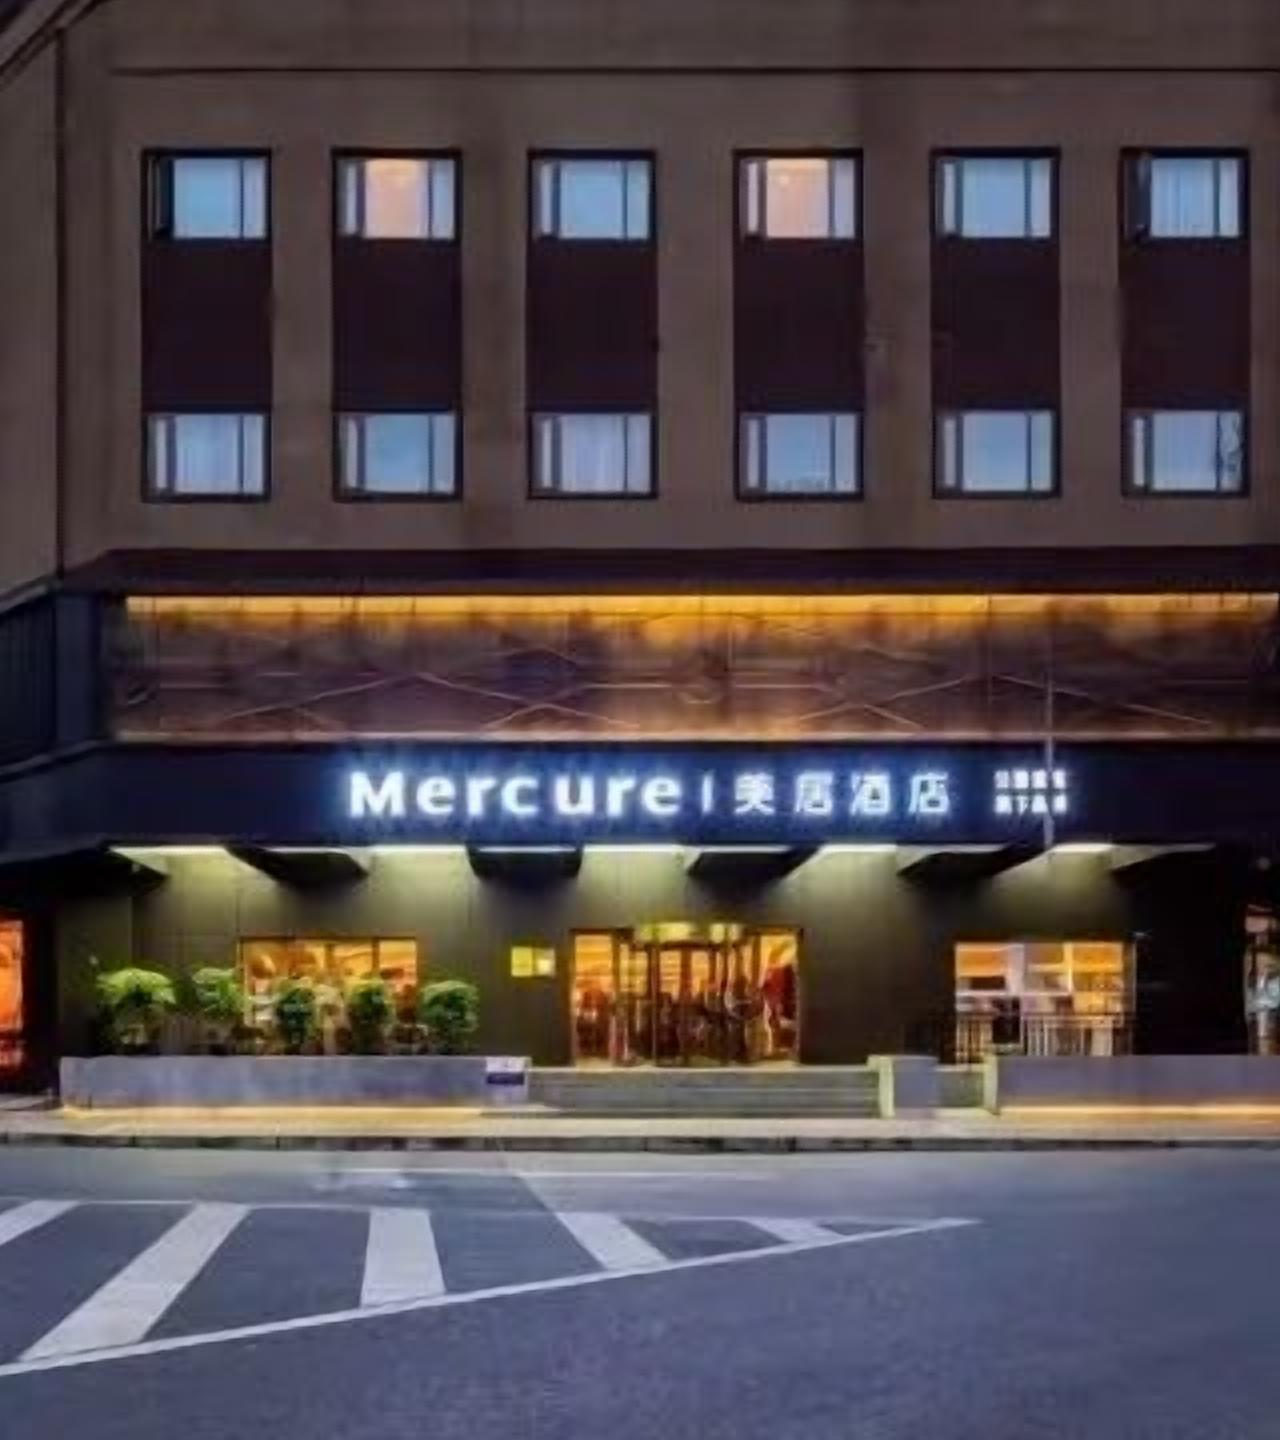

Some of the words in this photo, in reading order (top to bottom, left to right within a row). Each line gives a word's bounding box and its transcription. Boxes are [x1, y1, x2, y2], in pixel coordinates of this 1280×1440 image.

[348, 769, 685, 819] Mercure
[733, 770, 951, 816] 美居酒店
